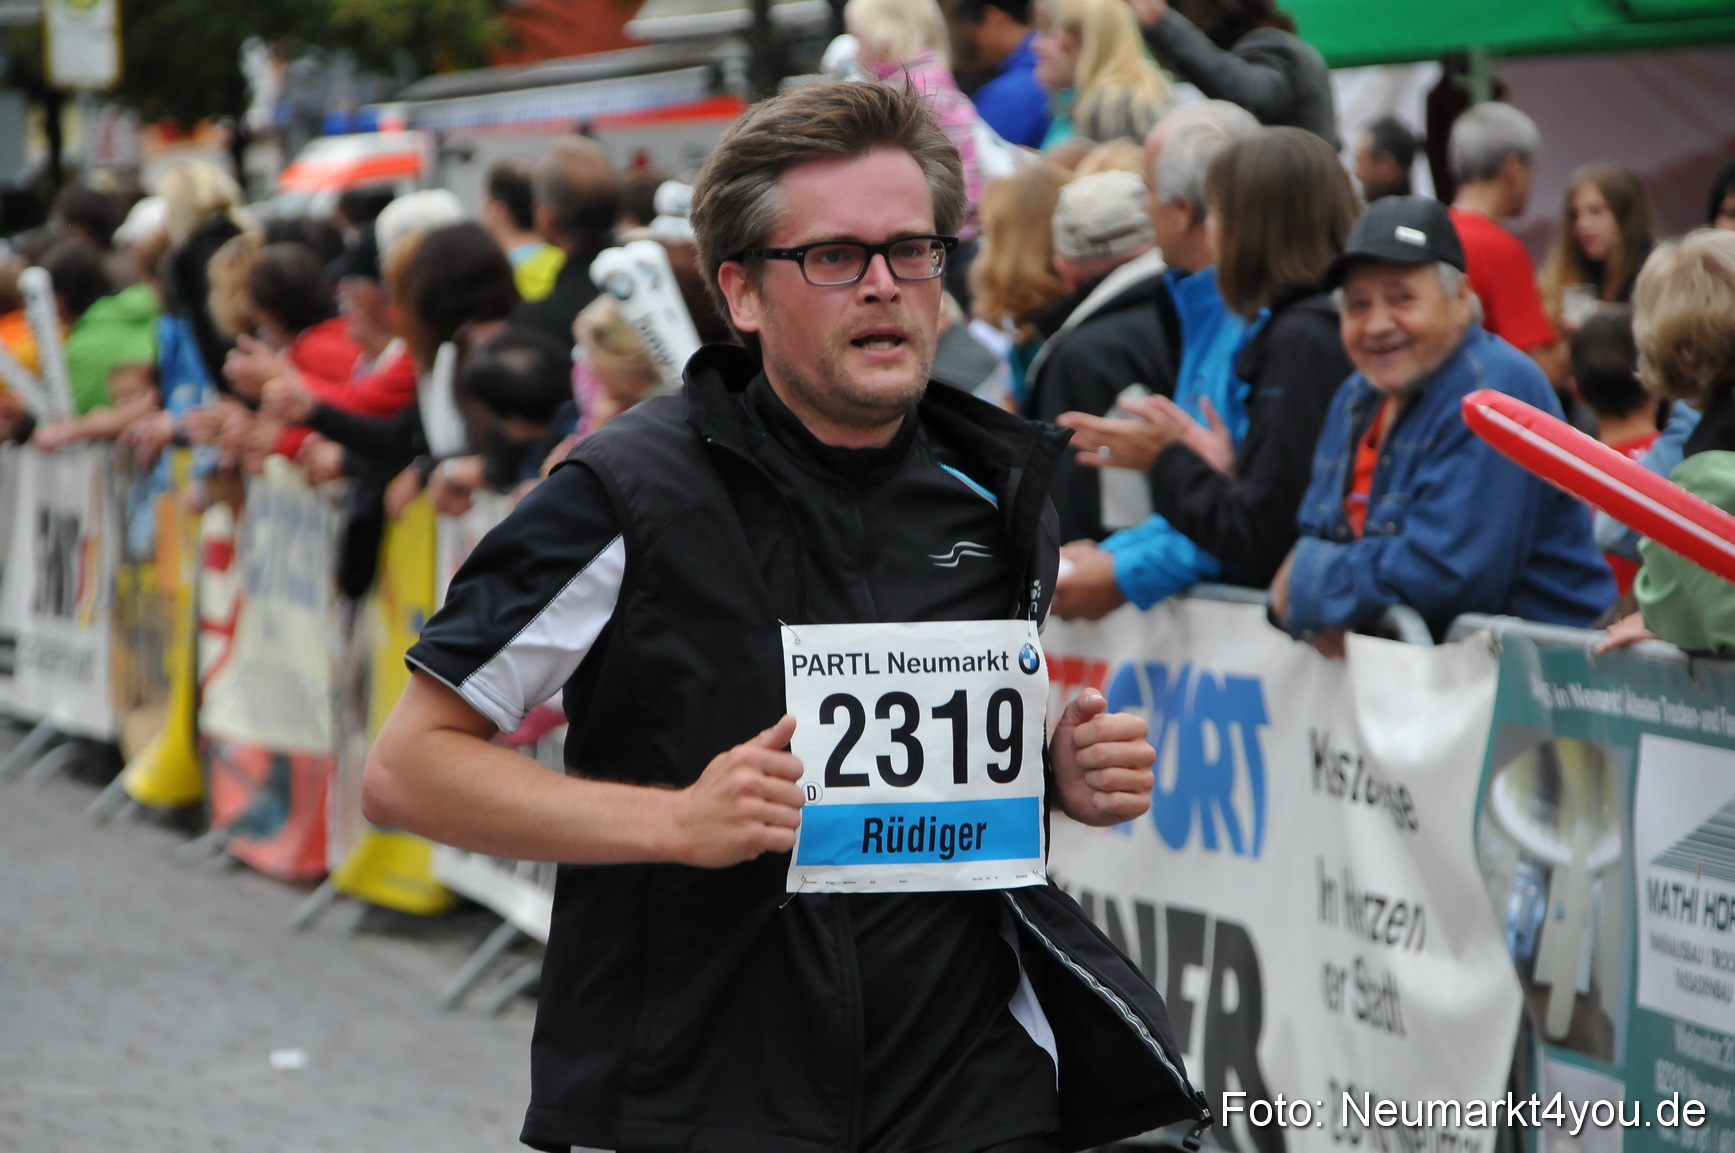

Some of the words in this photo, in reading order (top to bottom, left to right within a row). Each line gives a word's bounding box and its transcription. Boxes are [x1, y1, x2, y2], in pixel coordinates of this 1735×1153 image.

[791, 653, 880, 677] PARTL
[888, 650, 1009, 674] Neumarkt
[818, 688, 1024, 788] 2319
[806, 785, 818, 801] D
[861, 816, 987, 860] Rüdiger
